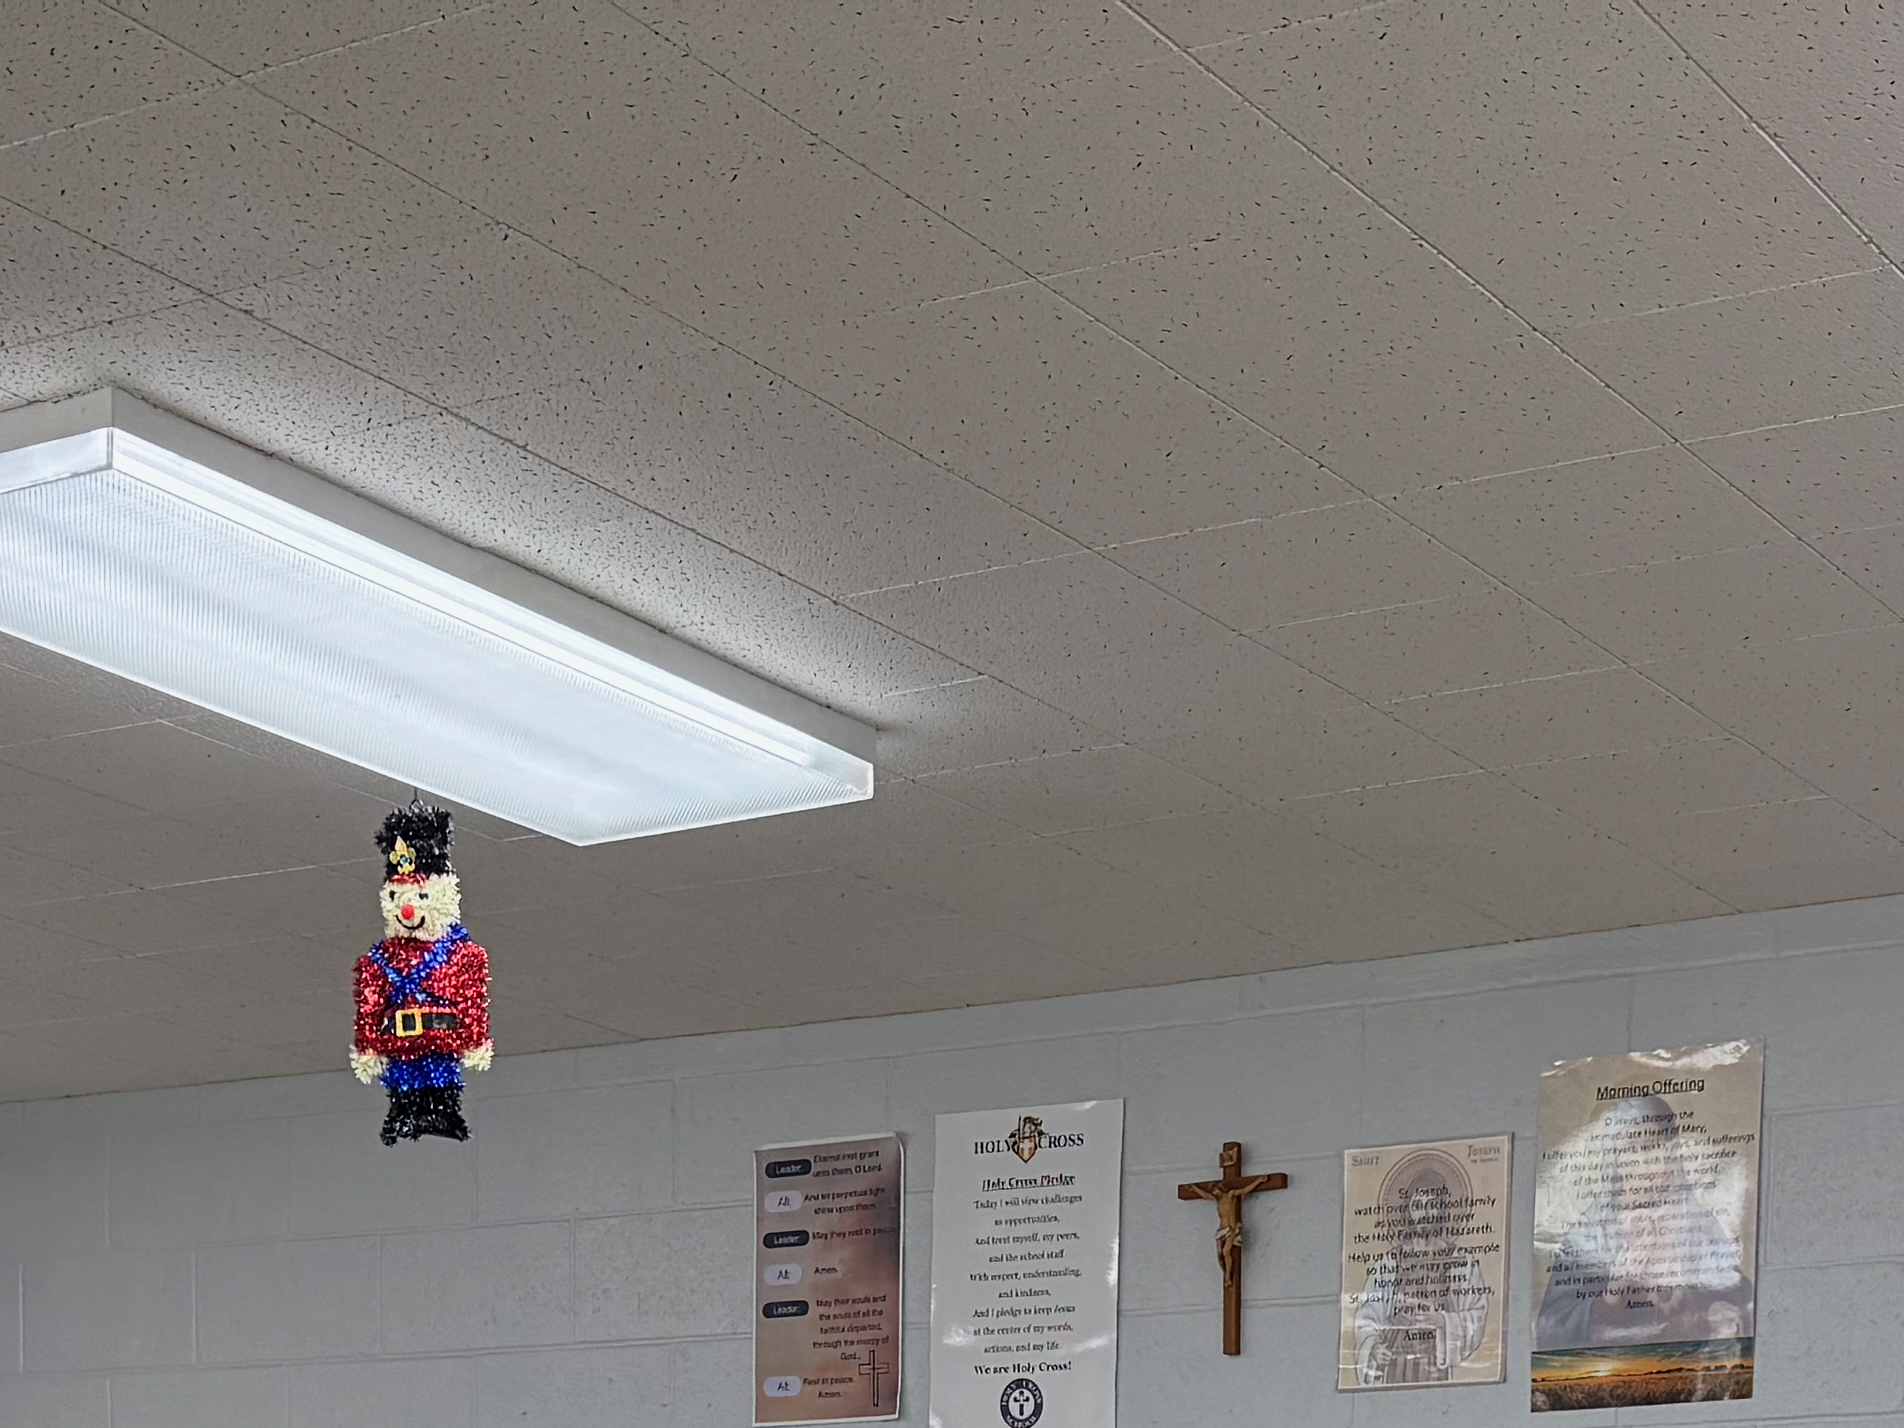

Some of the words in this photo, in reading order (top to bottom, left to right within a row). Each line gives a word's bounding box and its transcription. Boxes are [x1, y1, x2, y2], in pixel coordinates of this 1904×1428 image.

[1597, 1084, 1649, 1101] Morning
[1652, 1078, 1705, 1095] Offering
[975, 1139, 1013, 1154] HOLY
[1037, 1133, 1084, 1149] CROSS
